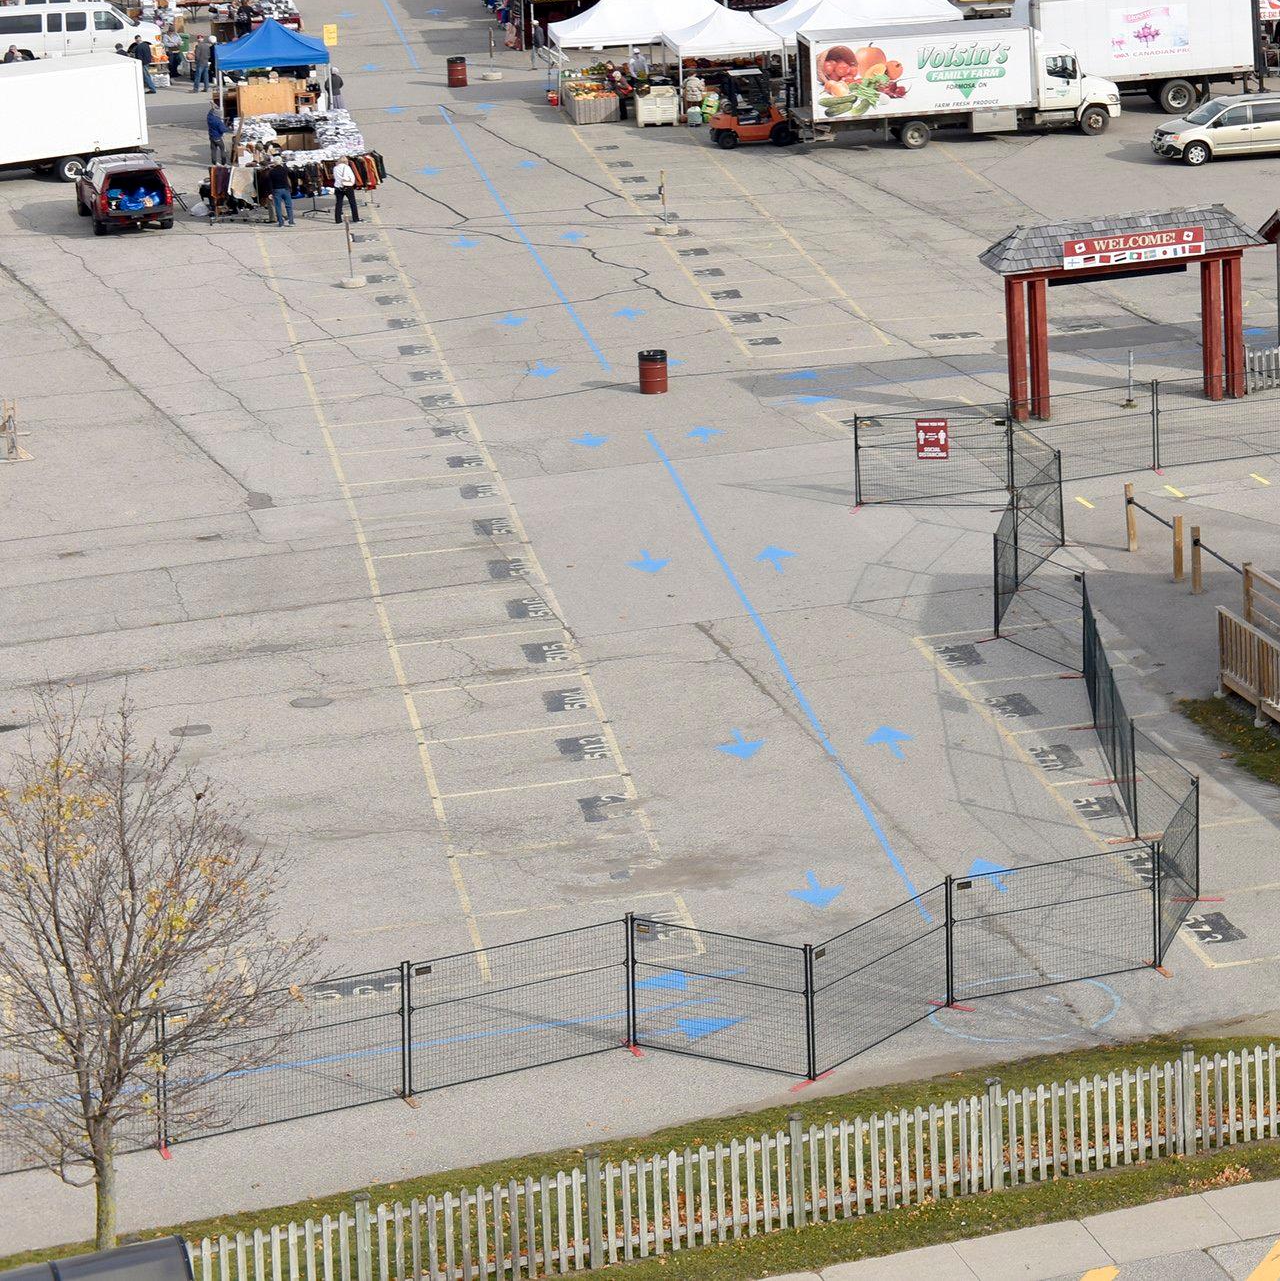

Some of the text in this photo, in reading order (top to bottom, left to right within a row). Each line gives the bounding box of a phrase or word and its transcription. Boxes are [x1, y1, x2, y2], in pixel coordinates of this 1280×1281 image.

[916, 42, 1011, 69] Voisin's
[1132, 49, 1176, 57] CANADIAN
[931, 69, 1000, 81] FAMILY FARM
[1093, 232, 1176, 252] WELCOME!
